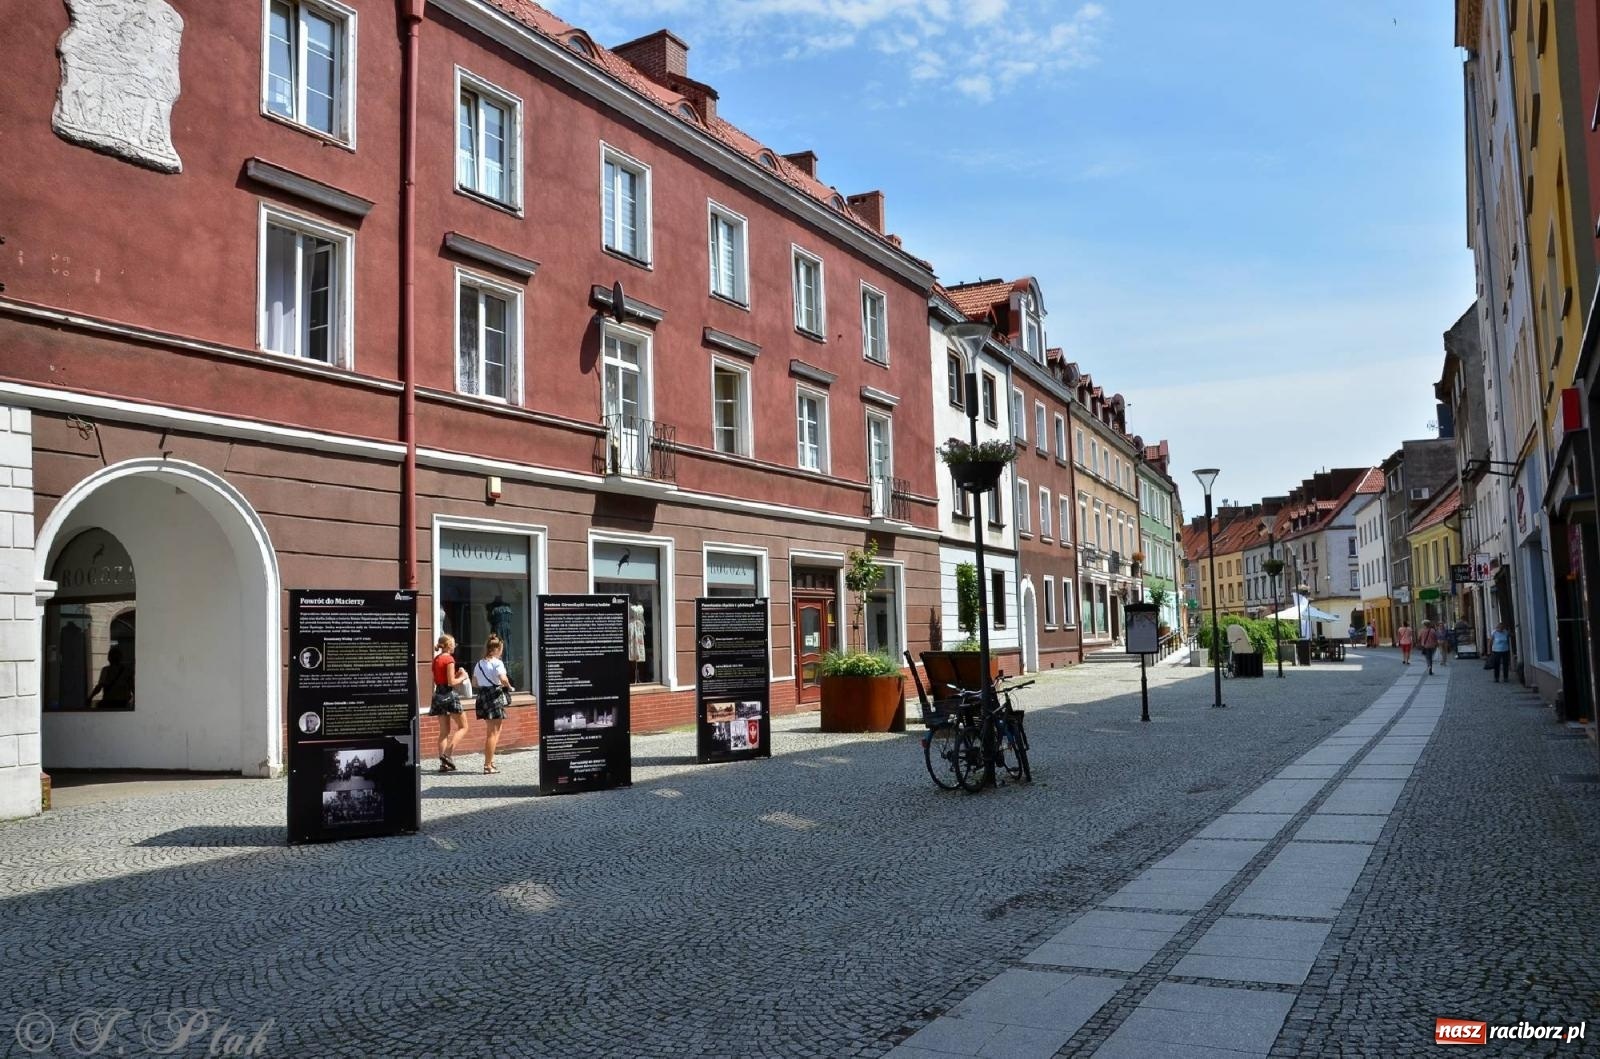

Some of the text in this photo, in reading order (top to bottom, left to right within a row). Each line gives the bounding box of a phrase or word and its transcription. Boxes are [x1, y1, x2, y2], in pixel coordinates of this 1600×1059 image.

[452, 543, 512, 561] ROGOZA
[711, 562, 746, 576] ROGOZA
[300, 597, 325, 605] Powrót
[335, 598, 365, 606] Macierzy
